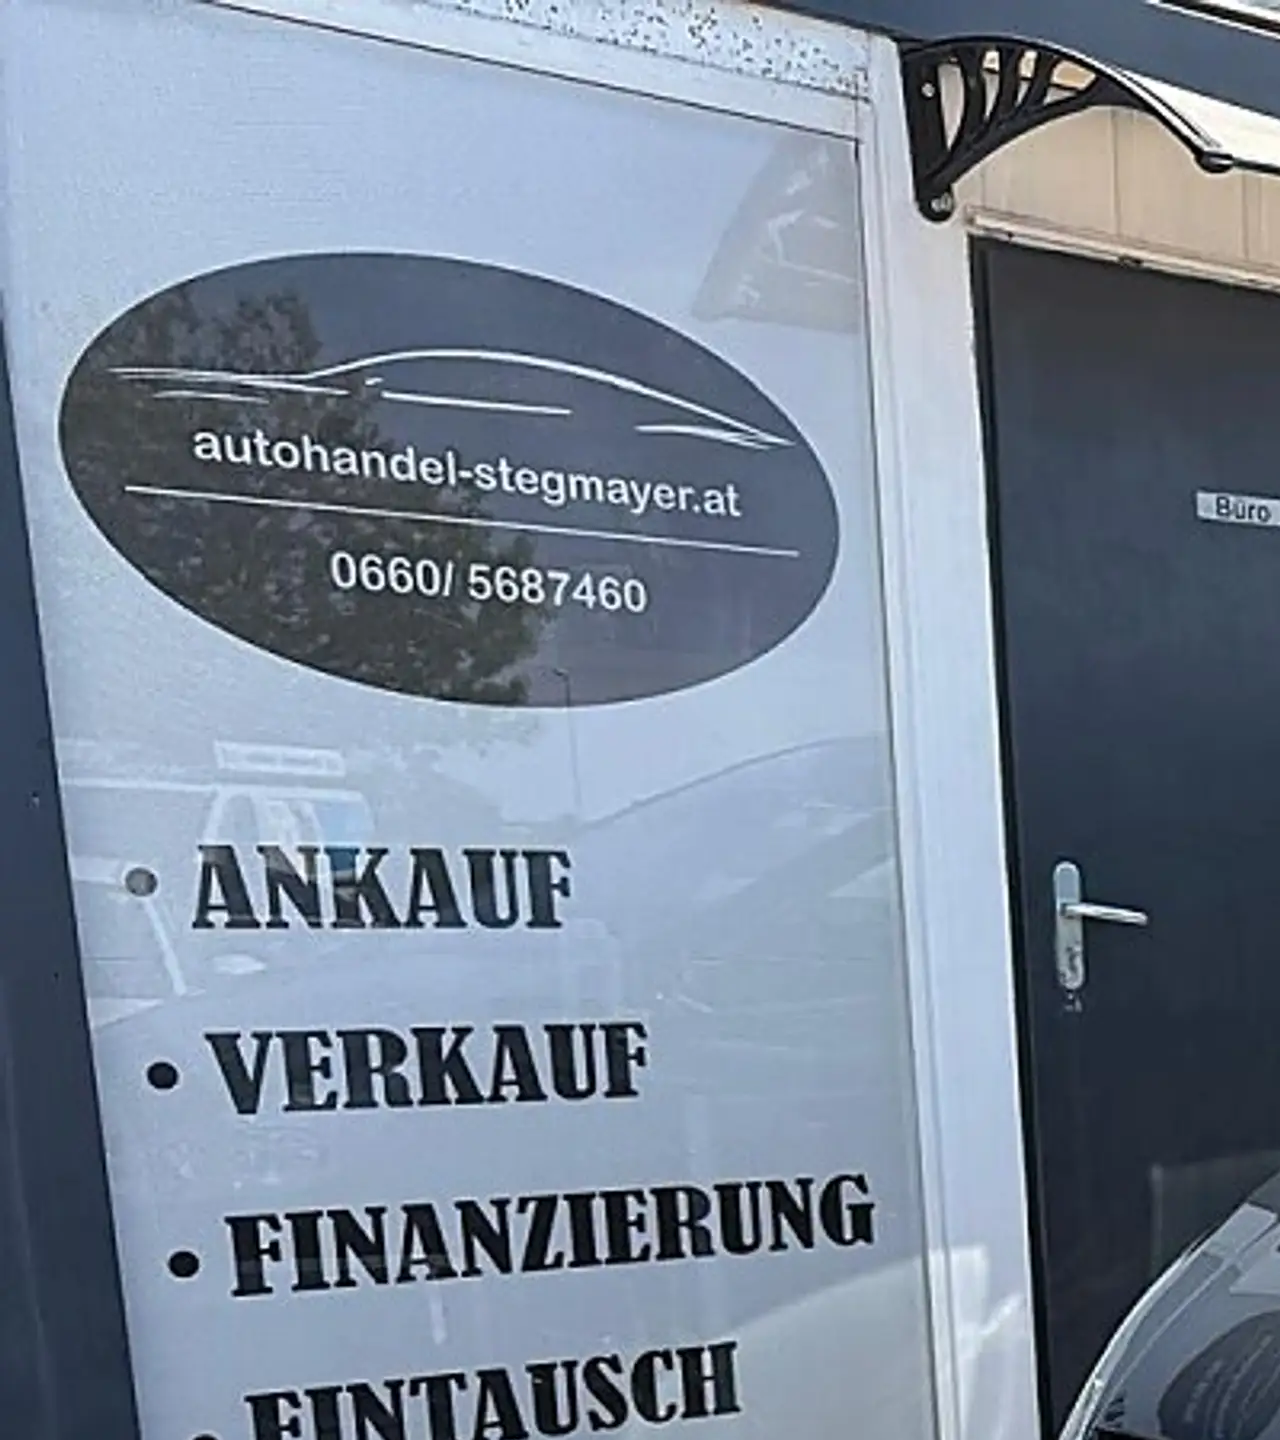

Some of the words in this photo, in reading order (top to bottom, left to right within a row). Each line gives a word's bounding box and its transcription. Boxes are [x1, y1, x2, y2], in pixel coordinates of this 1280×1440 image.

[193, 428, 742, 517] autohandel-stegmayer.at
[1215, 496, 1272, 522] Büro
[330, 550, 455, 600] 0660/
[467, 562, 648, 614] 5687460
[192, 844, 571, 930] ANKAUF
[204, 1022, 649, 1116] VERKAUF
[224, 1172, 877, 1299] FINANZIERUNG
